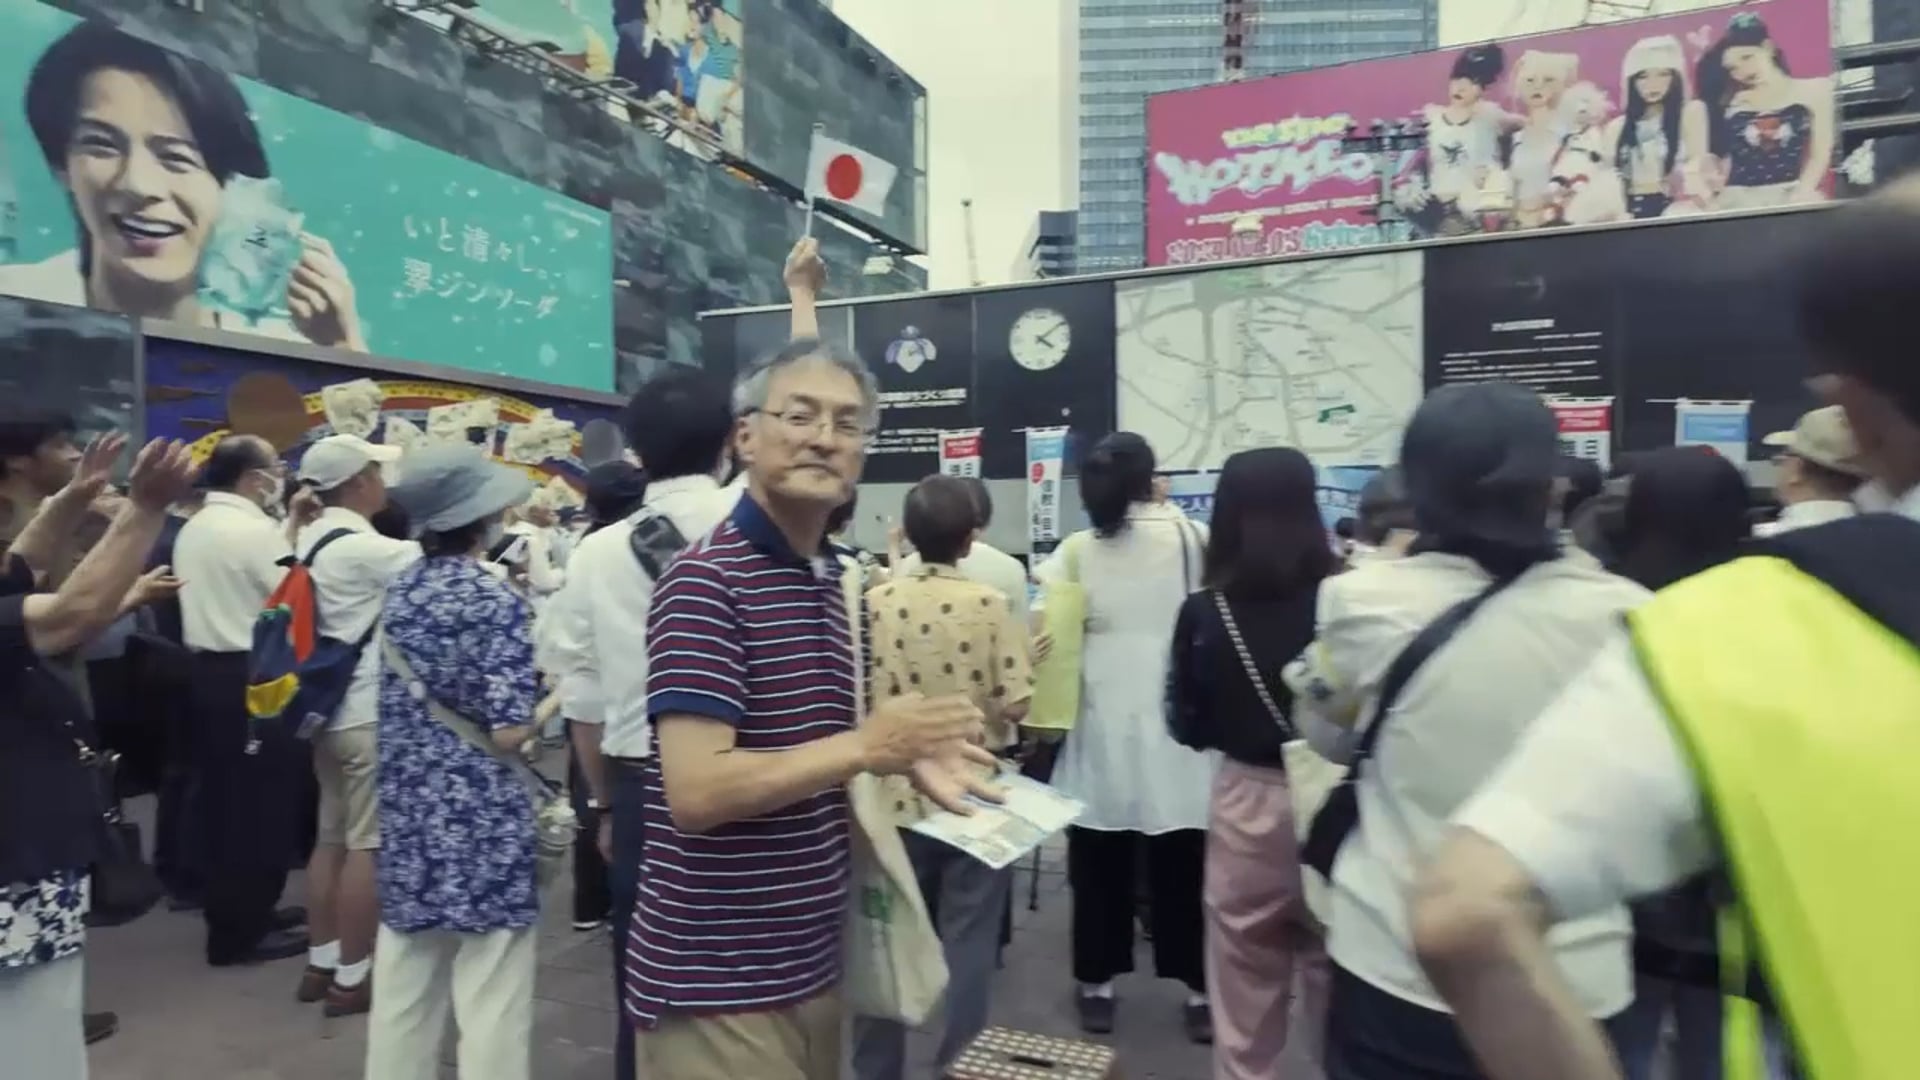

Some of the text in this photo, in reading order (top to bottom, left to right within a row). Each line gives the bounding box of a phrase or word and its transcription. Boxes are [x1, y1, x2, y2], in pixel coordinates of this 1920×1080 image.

[404, 256, 560, 319] 翠ジンソーダ
